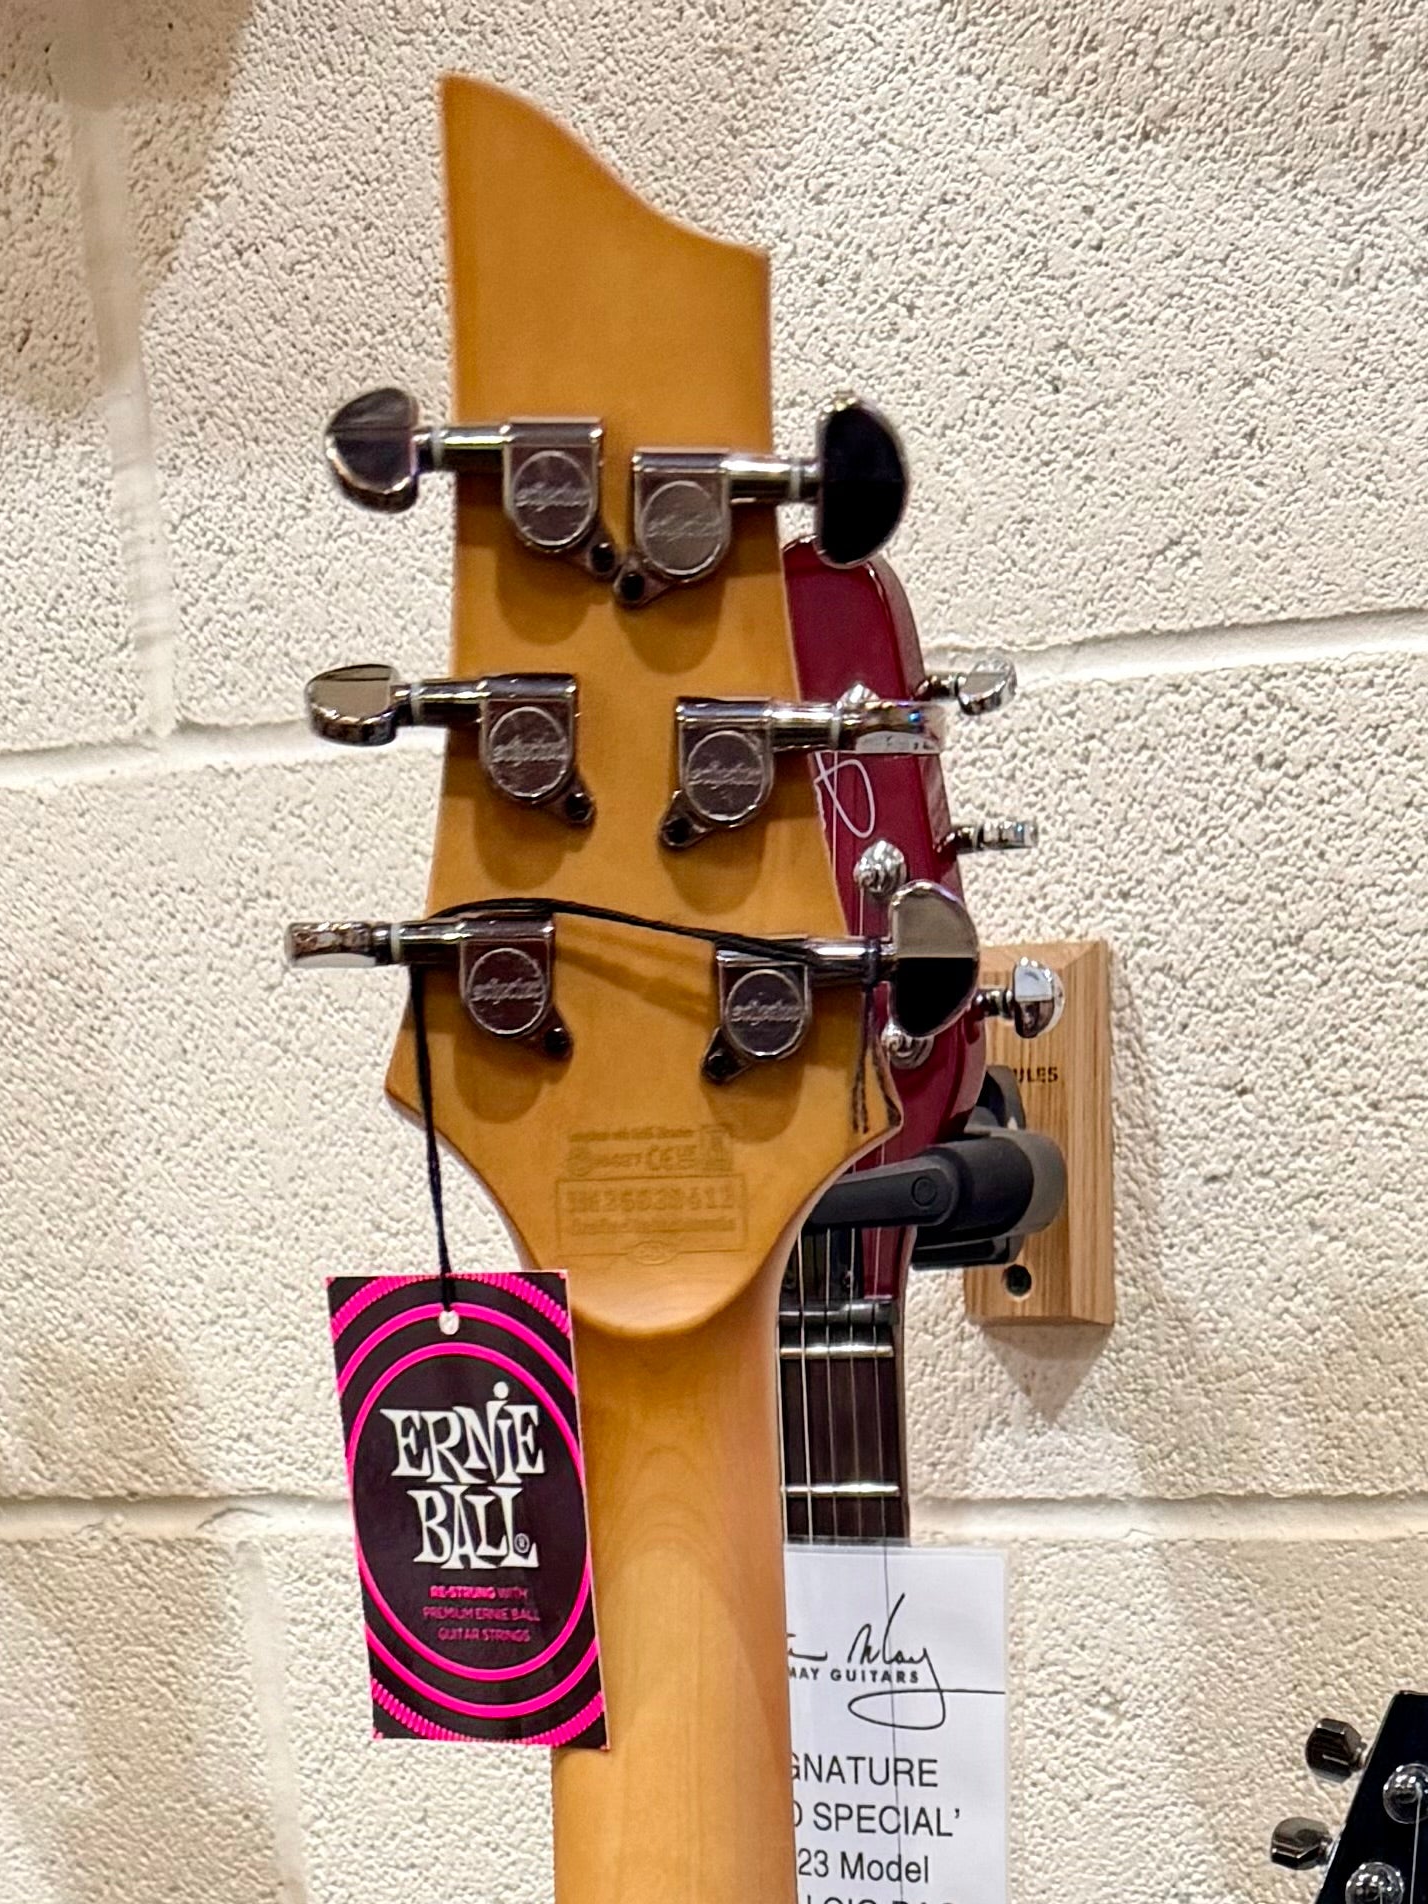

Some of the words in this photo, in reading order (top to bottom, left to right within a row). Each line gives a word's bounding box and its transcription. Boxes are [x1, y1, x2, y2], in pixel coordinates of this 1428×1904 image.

[830, 1668, 919, 1683] GUITARS
[791, 1752, 938, 1788] NATURE
[841, 1853, 930, 1885] Model
